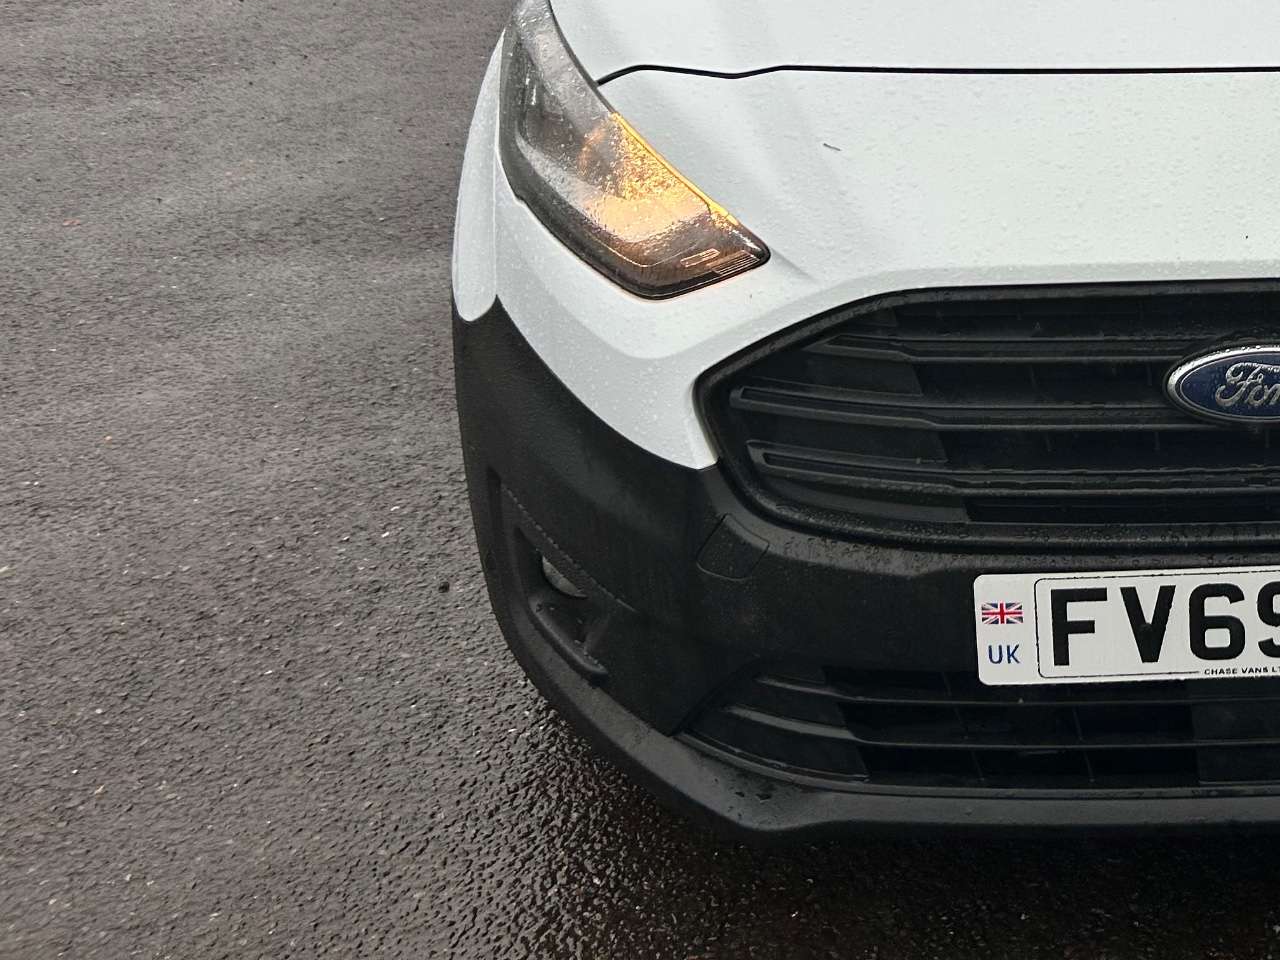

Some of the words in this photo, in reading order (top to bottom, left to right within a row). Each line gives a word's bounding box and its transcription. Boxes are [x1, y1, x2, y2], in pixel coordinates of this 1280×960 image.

[988, 644, 1021, 665] UK
[1204, 667, 1238, 676] CHASE
[1241, 666, 1269, 674] VANS
